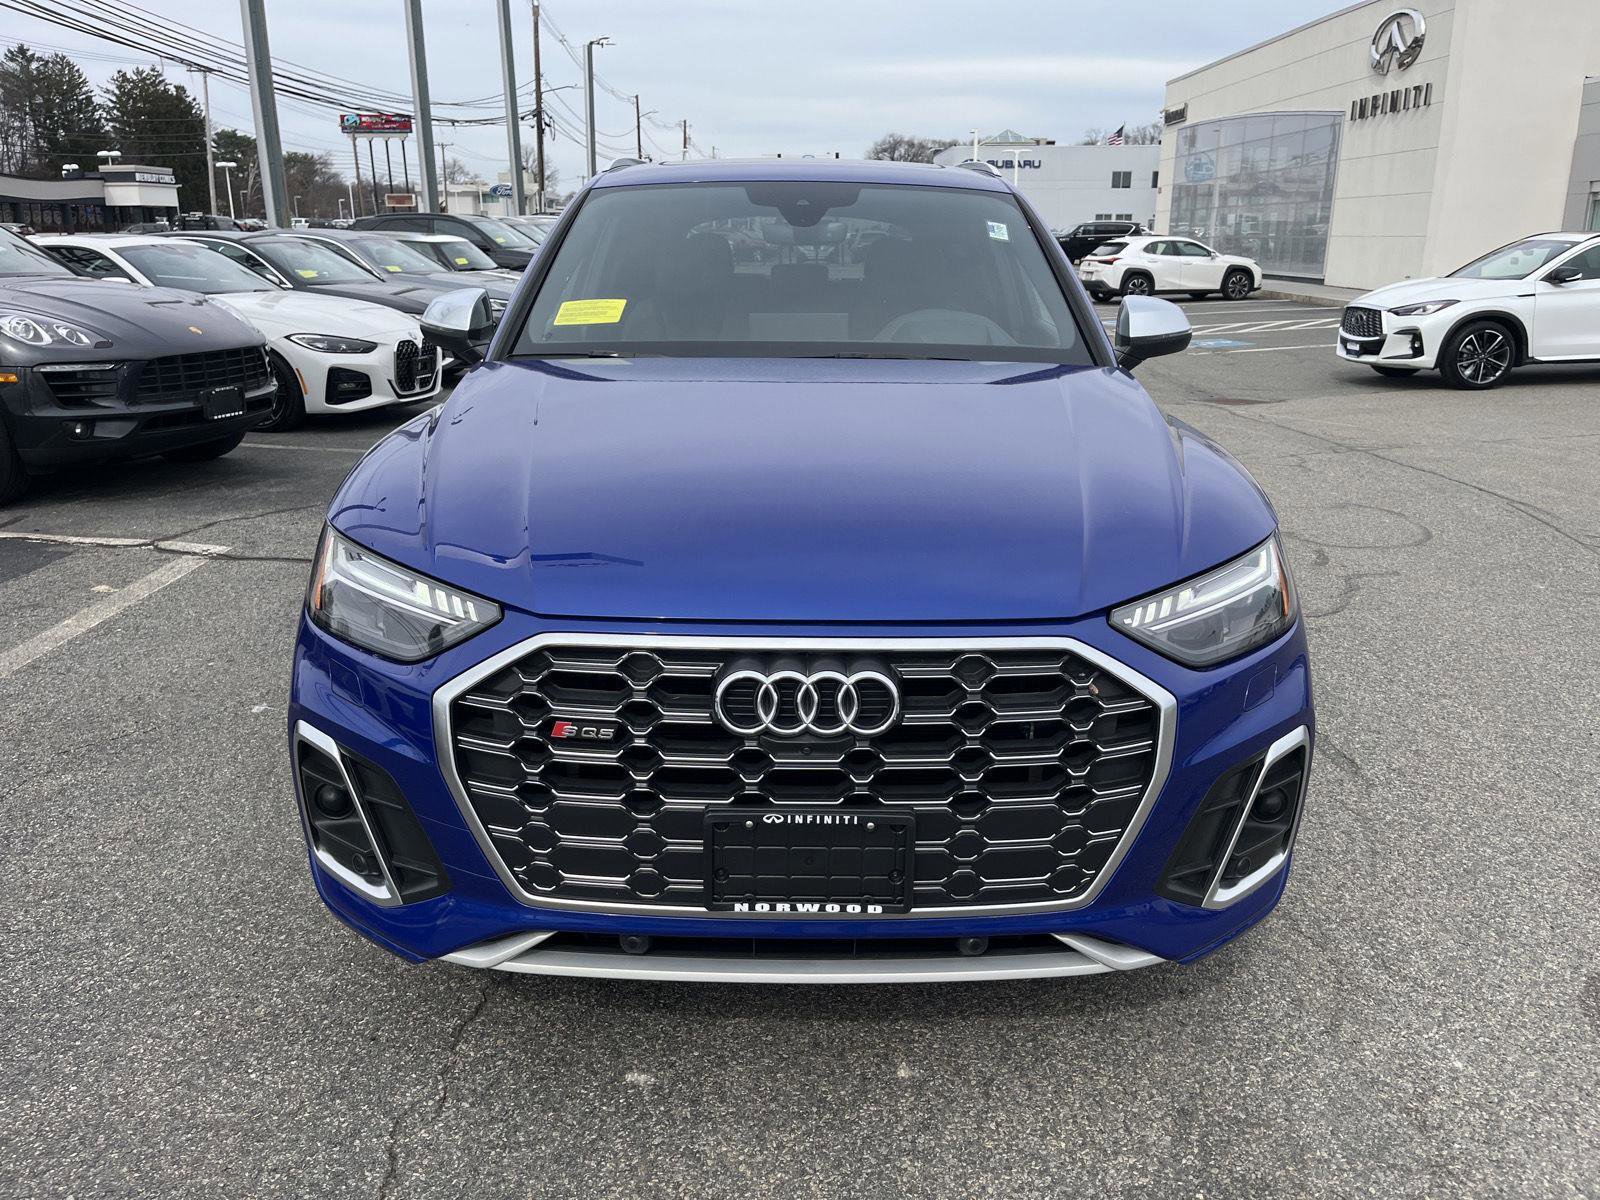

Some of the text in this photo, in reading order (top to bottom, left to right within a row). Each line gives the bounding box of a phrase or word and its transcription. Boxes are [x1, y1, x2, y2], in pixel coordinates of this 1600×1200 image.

[1351, 83, 1432, 121] INFINITI
[561, 725, 615, 740] SQ5
[787, 814, 858, 825] INFINITI
[734, 902, 883, 914] NORWOOD
